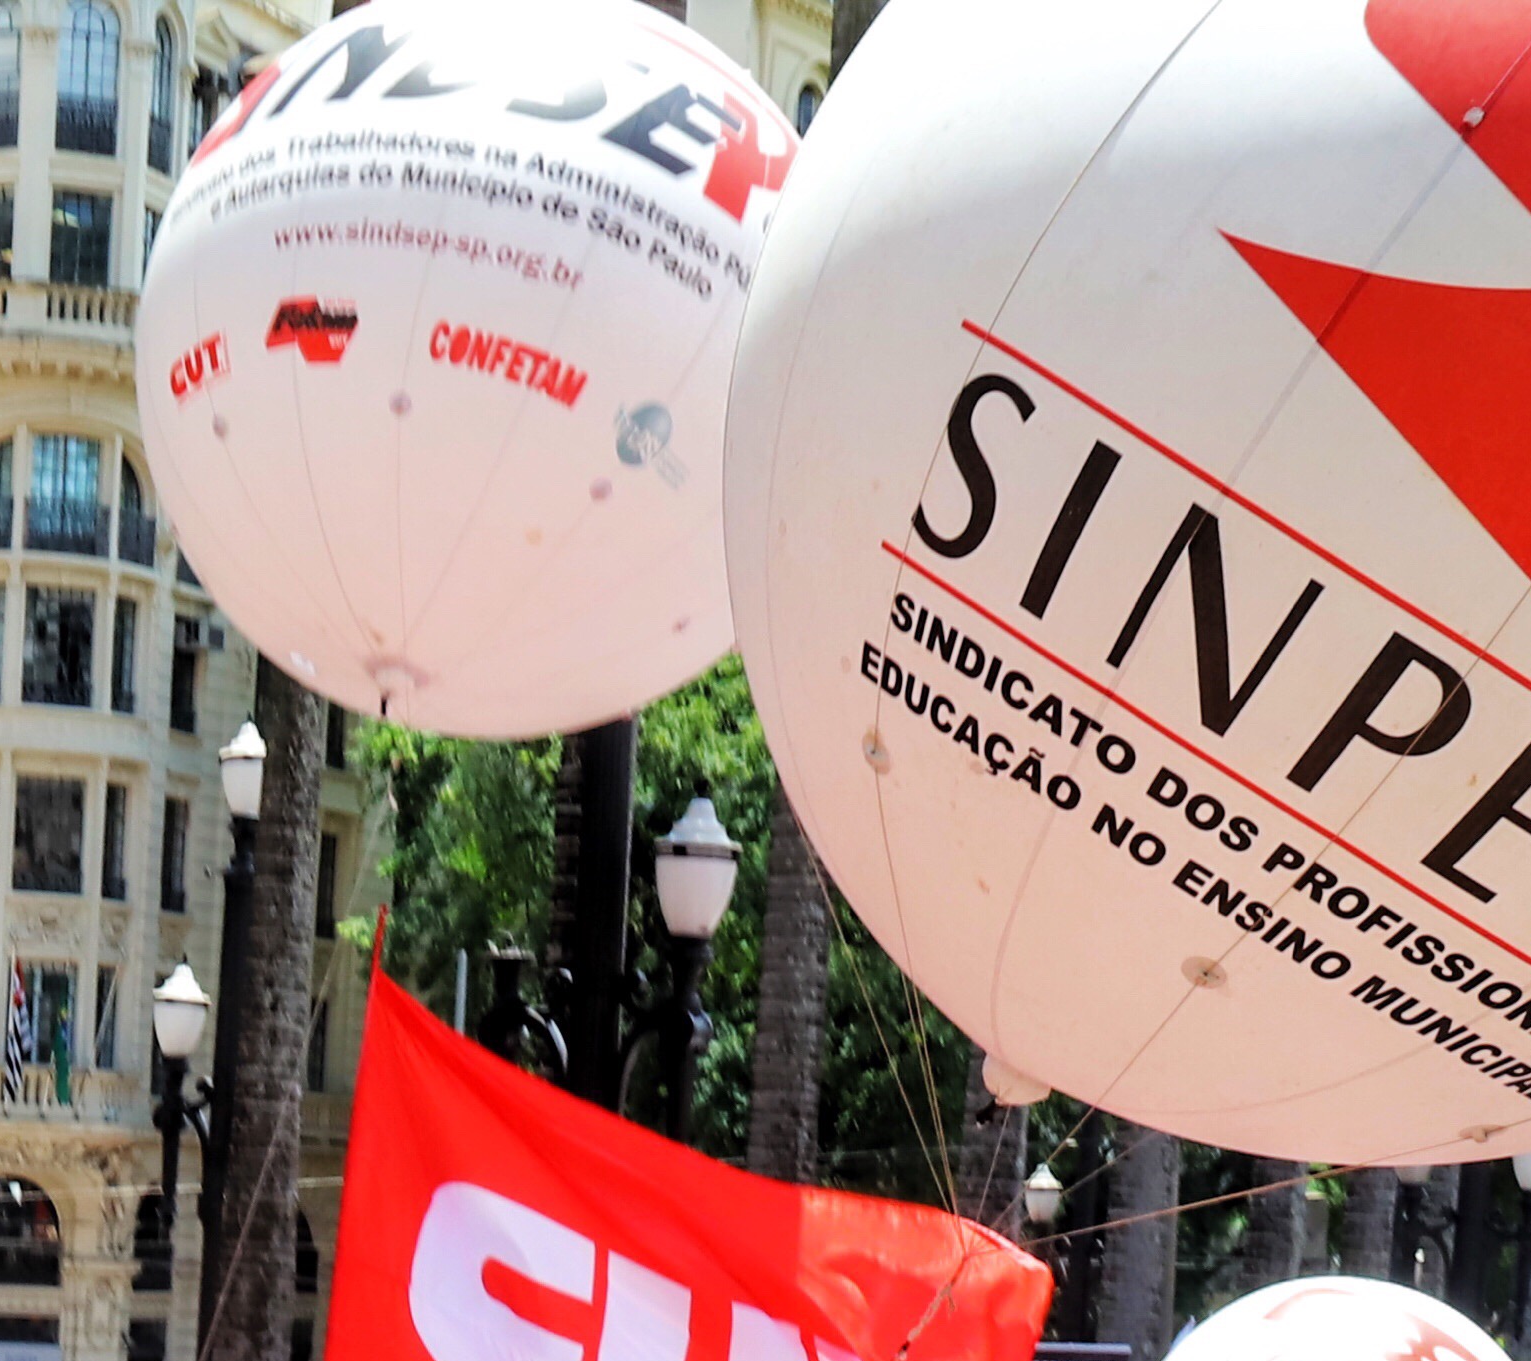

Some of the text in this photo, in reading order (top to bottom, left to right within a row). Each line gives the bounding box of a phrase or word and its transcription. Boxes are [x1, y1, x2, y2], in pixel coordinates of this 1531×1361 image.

[526, 151, 721, 262] Administração
[542, 190, 579, 222] de
[587, 207, 641, 249] São
[648, 238, 713, 300] Paulo
[168, 331, 228, 398] CUT
[428, 318, 589, 410] CONFETAM
[890, 591, 1137, 775] SINDICATO
[1146, 765, 1259, 852] DOS
[860, 640, 1082, 815] EDUCAÇÃO
[1091, 803, 1167, 867] NO
[1172, 859, 1352, 980] ENSINO
